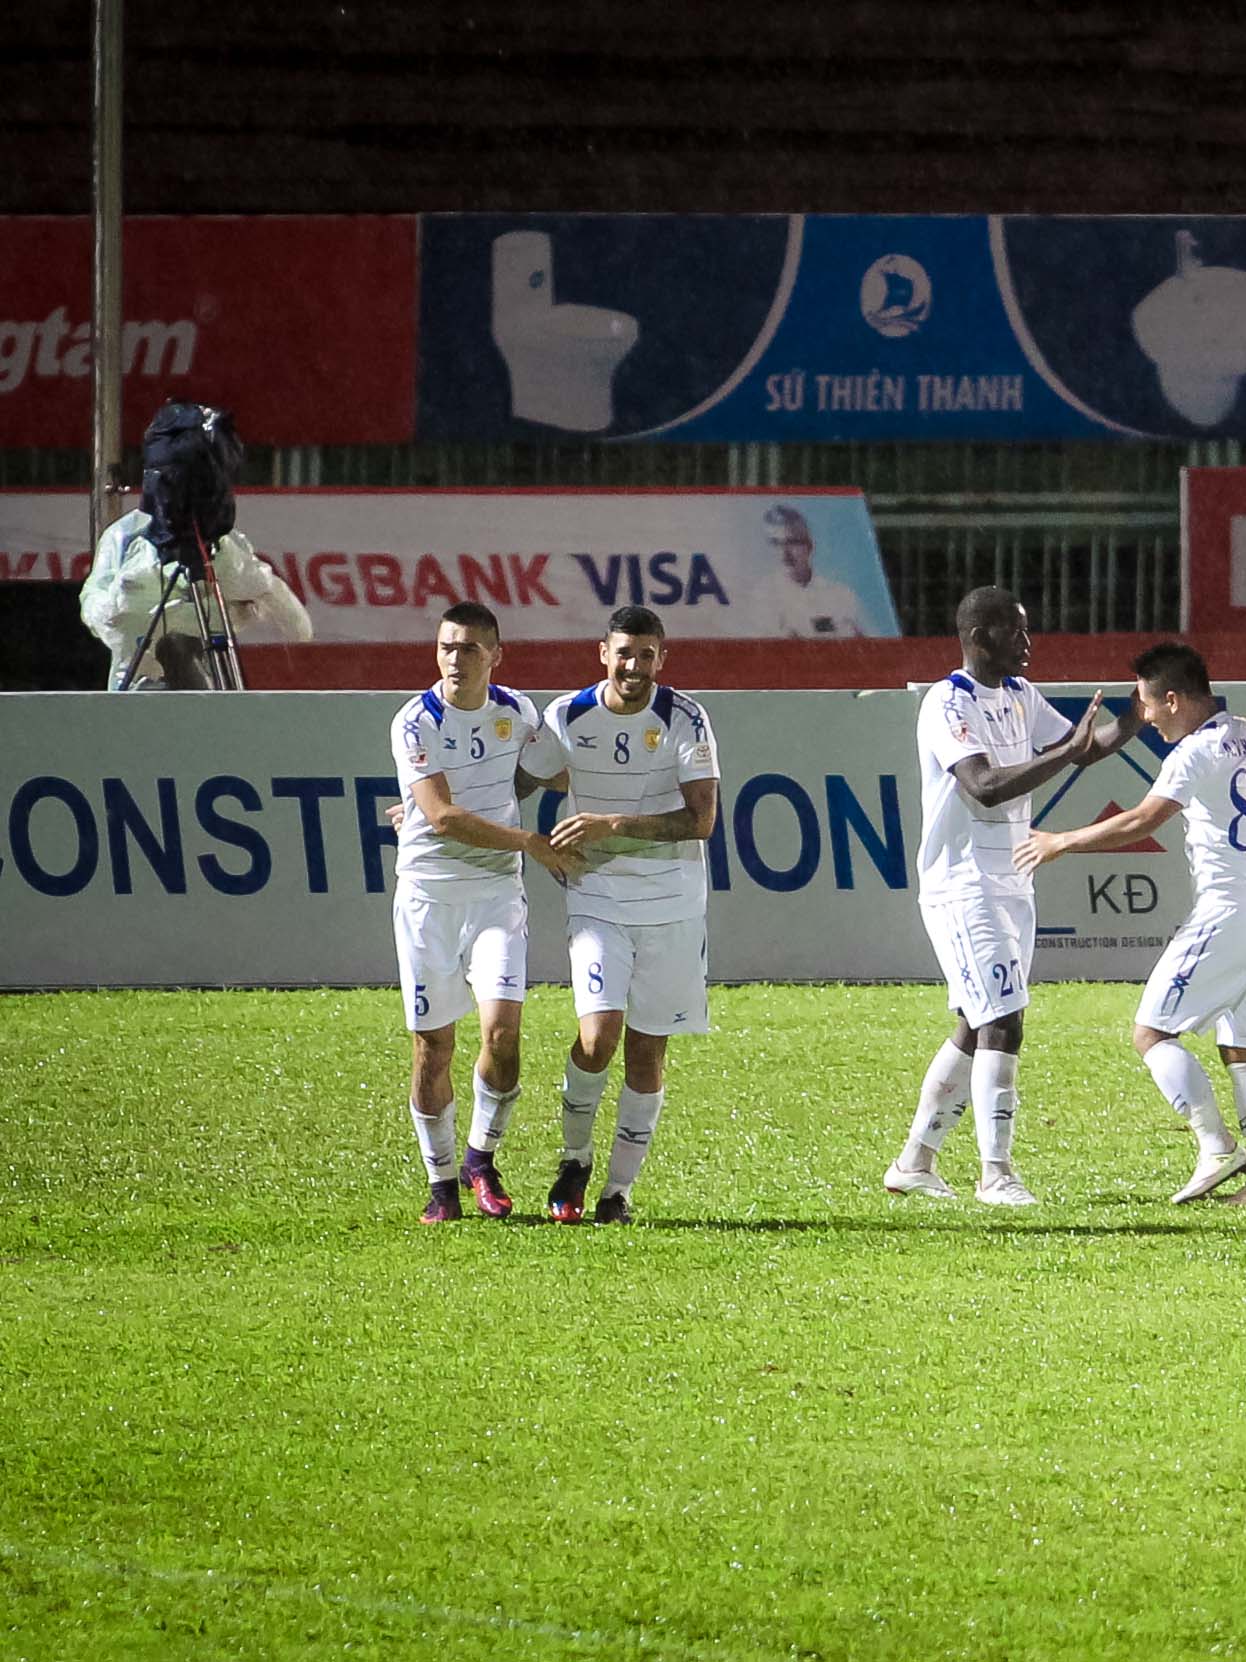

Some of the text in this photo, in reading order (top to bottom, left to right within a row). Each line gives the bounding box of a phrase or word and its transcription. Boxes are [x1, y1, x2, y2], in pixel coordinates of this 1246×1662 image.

[917, 374, 1024, 412] THANH
[568, 552, 730, 606] VISA
[470, 726, 485, 760] 5
[613, 731, 630, 765] 8
[1087, 873, 1158, 914] KĐ
[1034, 936, 1118, 949] CONSTRUCTION
[1121, 934, 1164, 947] DESIGN
[588, 961, 604, 994] 8
[414, 984, 430, 1017] 5
